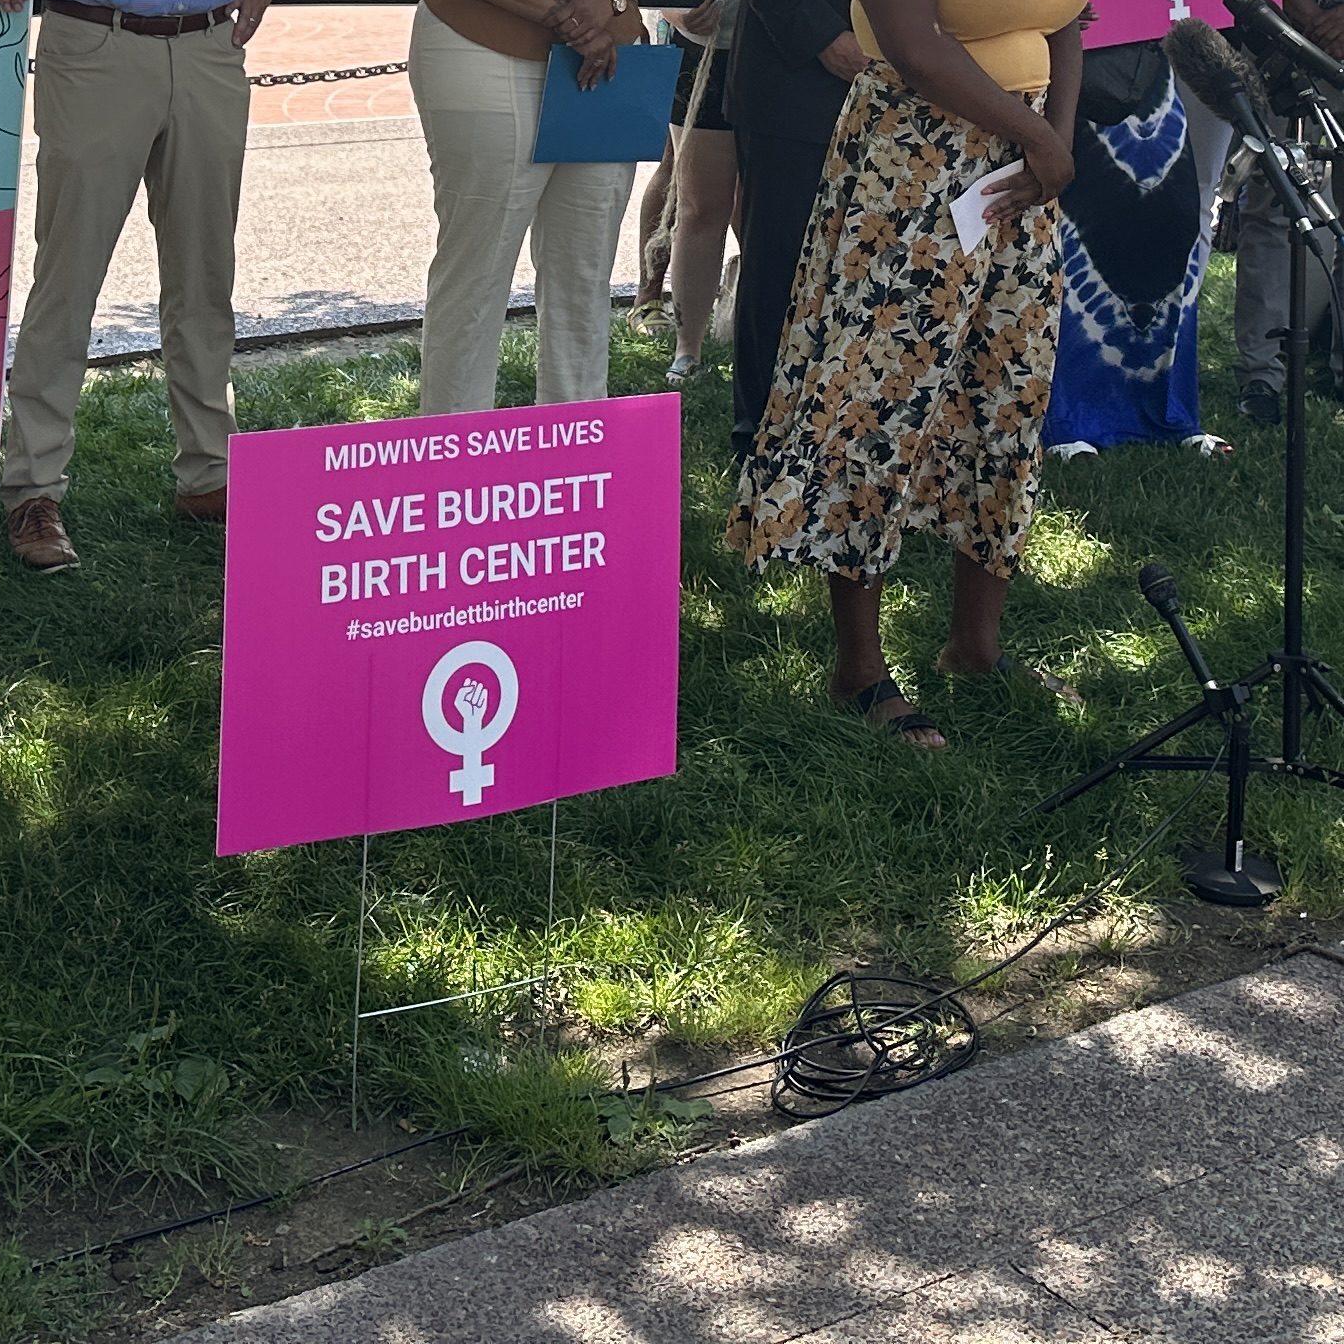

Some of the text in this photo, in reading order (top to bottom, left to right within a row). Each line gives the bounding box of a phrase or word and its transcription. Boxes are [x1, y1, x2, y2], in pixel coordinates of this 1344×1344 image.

[325, 419, 604, 472] MIDWIVES SAVE LIVES
[315, 472, 612, 543] SAVE BURDETT
[321, 531, 606, 604] BIRTH CENTER
[346, 591, 585, 641] #saveburdettbirthcenter
